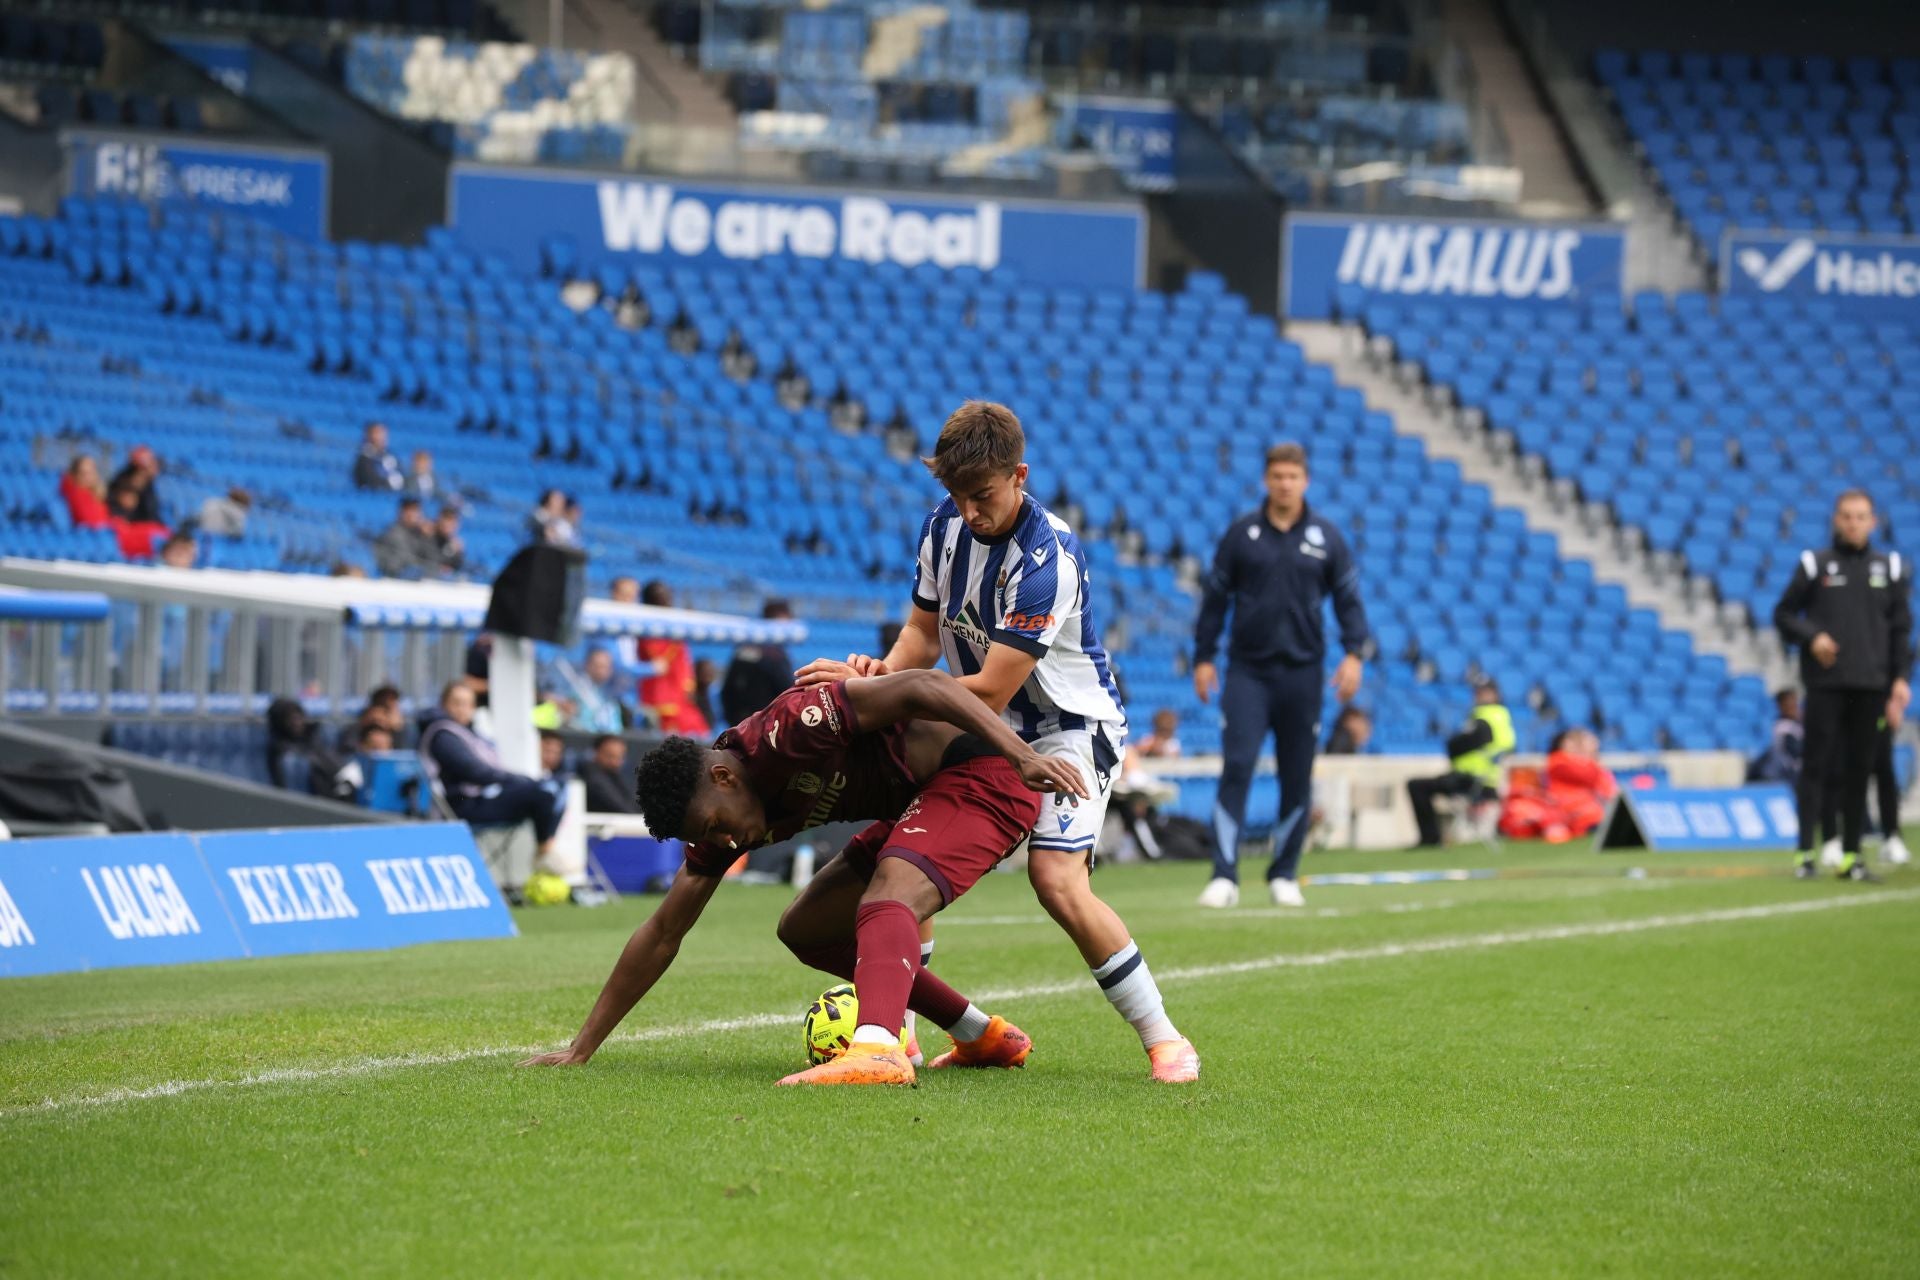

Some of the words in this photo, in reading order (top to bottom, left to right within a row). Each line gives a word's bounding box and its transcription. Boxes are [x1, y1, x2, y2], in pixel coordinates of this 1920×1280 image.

[598, 180, 713, 256] We
[714, 201, 838, 260] are
[840, 197, 1001, 271] Real
[1336, 223, 1581, 300] INSALUS
[1815, 251, 1920, 297] Halc
[942, 618, 990, 650] AMENAB
[80, 863, 201, 939] LALIGA
[227, 862, 360, 924] KELER
[365, 854, 491, 916] KELER
